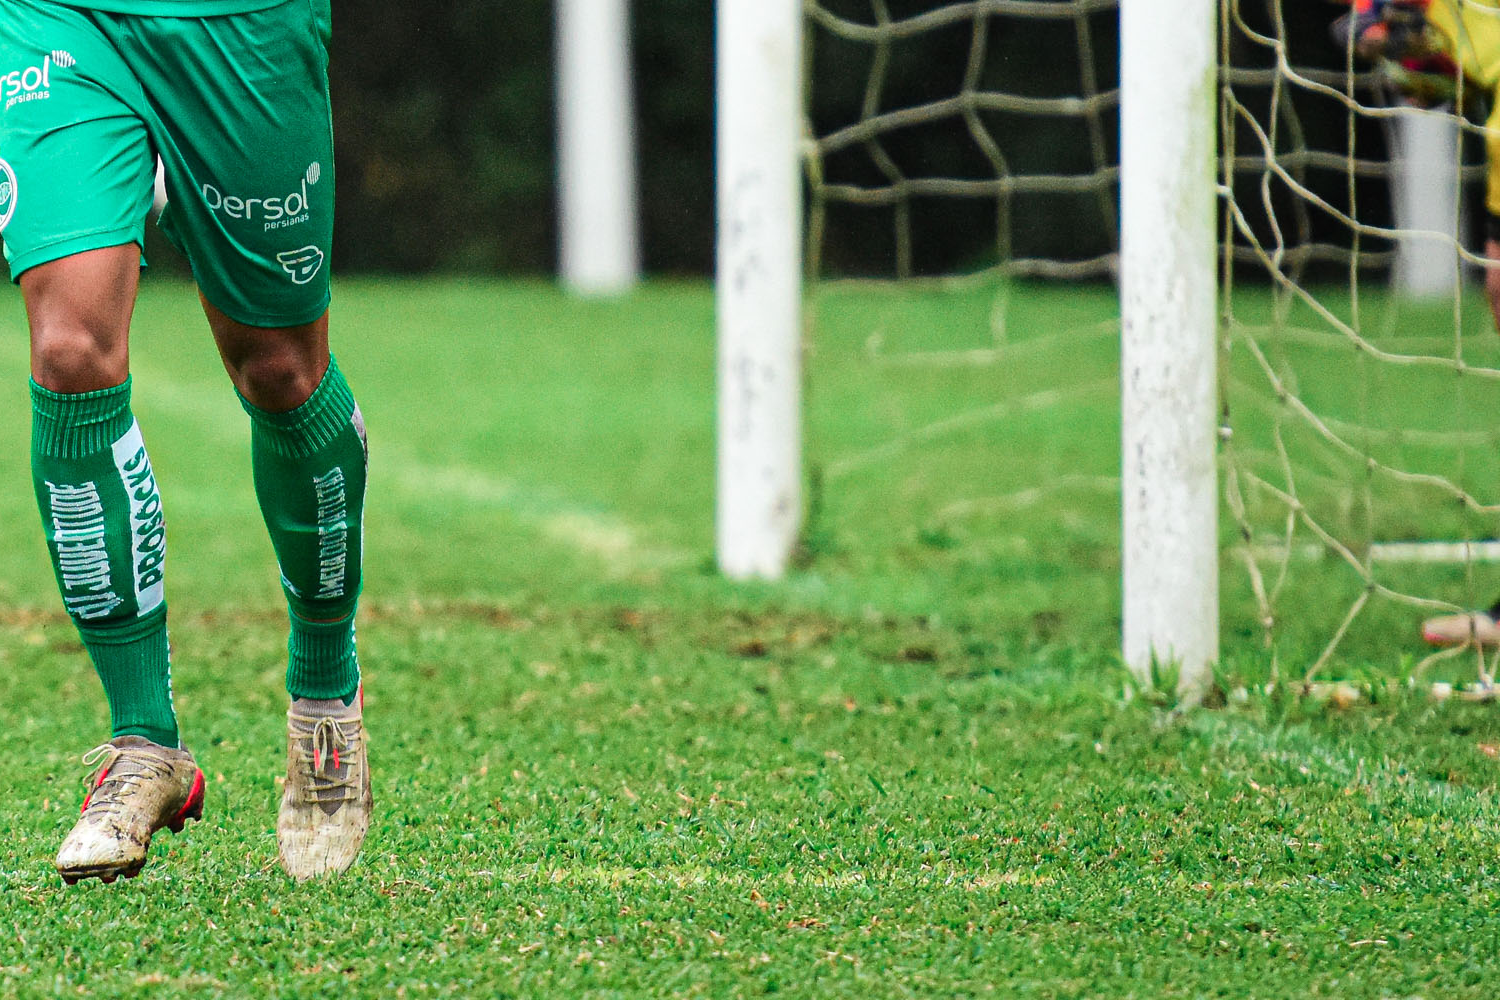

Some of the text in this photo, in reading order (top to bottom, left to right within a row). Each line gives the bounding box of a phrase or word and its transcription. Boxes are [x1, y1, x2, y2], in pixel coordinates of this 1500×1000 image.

[5, 90, 50, 112] persianas
[202, 178, 309, 220] persol
[264, 212, 310, 232] persianas
[44, 480, 112, 591] JUVENTUDE
[123, 446, 165, 592] PROSOCKS
